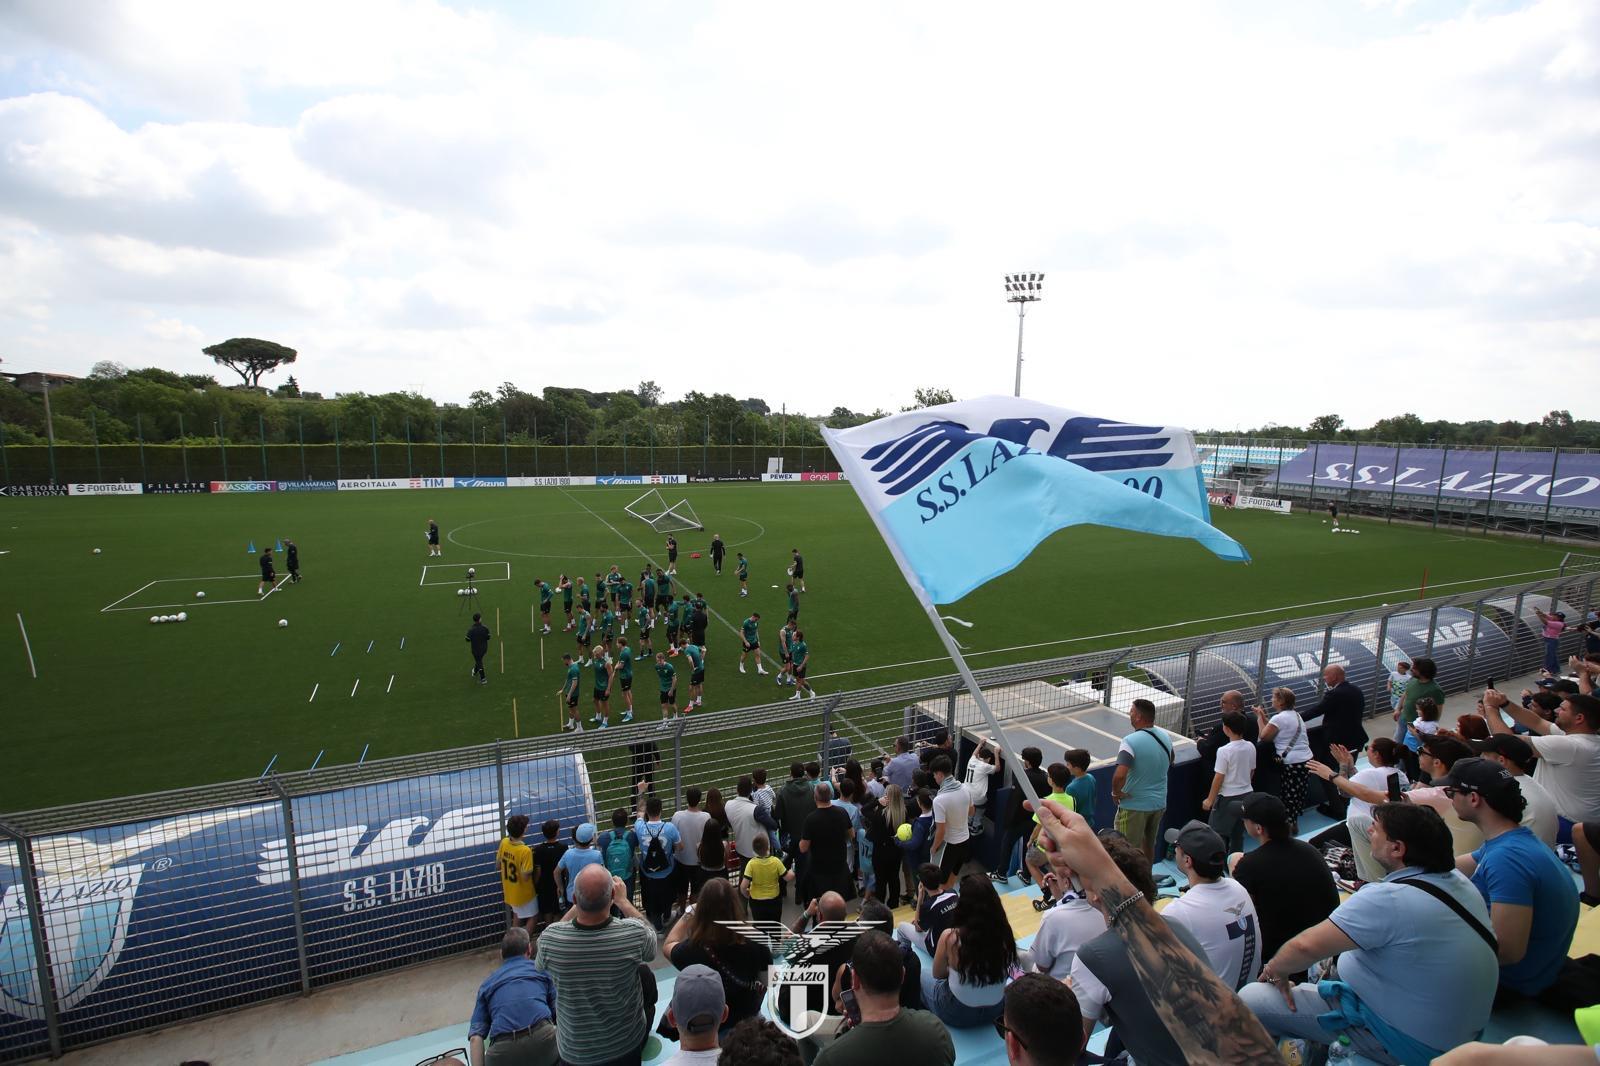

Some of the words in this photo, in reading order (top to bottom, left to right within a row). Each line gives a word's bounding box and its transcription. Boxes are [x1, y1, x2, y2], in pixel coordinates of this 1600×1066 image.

[545, 477, 558, 486] LAZIO
[662, 476, 679, 484] TIM
[810, 473, 830, 481] enel
[1307, 463, 1600, 498] S.S.LAZIO
[218, 483, 271, 491] MASSIGEN
[340, 481, 397, 489] AEROITALIA
[423, 478, 444, 488] TIM
[502, 859, 518, 884] 13
[343, 875, 383, 913] S.S.
[390, 861, 446, 903] LAZIO
